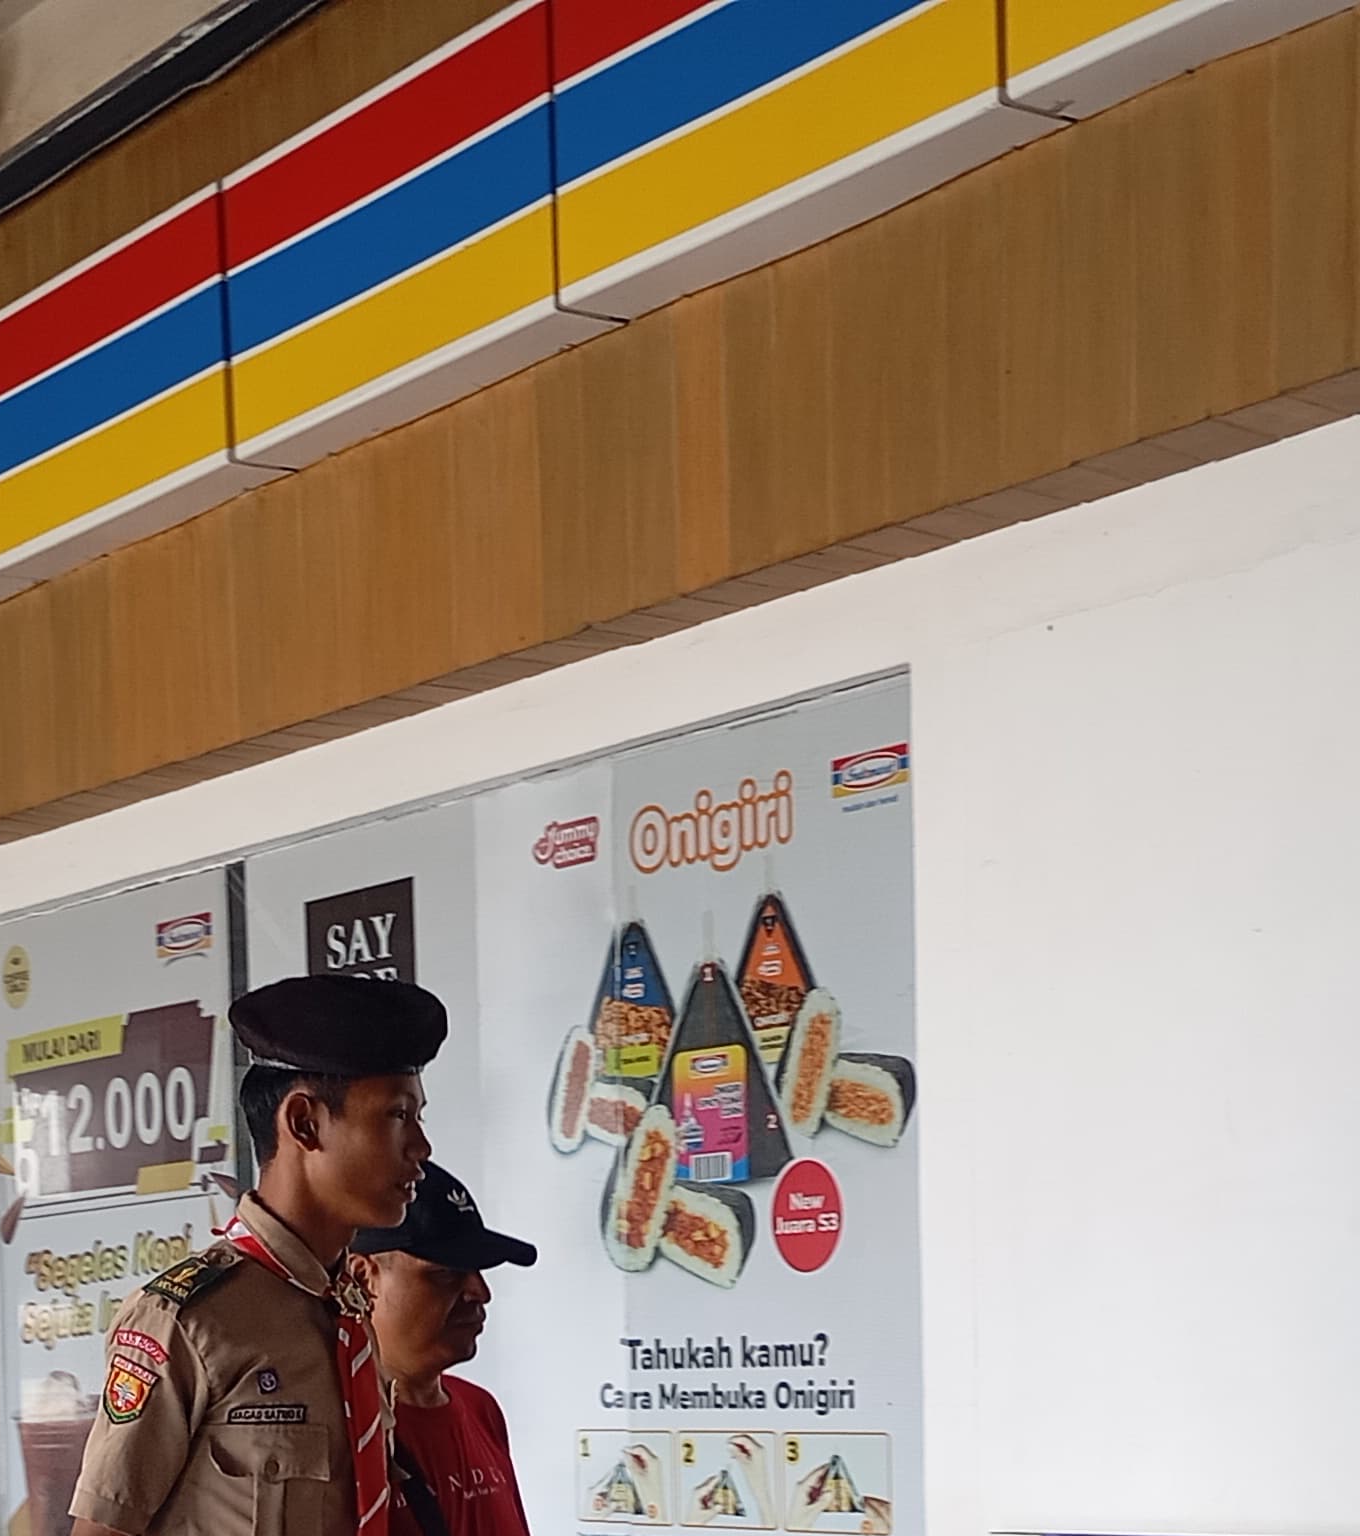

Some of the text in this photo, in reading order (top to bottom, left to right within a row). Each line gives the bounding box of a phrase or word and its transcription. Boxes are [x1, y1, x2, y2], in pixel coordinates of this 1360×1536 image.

[630, 769, 795, 874] Onigiri
[326, 912, 397, 969] SAY
[788, 1192, 825, 1211] New
[620, 1332, 831, 1371] Tahukah kamu?
[599, 1378, 856, 1416] Cara Membuka Onigiri
[580, 1438, 591, 1458] 1
[682, 1442, 696, 1464] 2
[787, 1440, 801, 1463] 3
